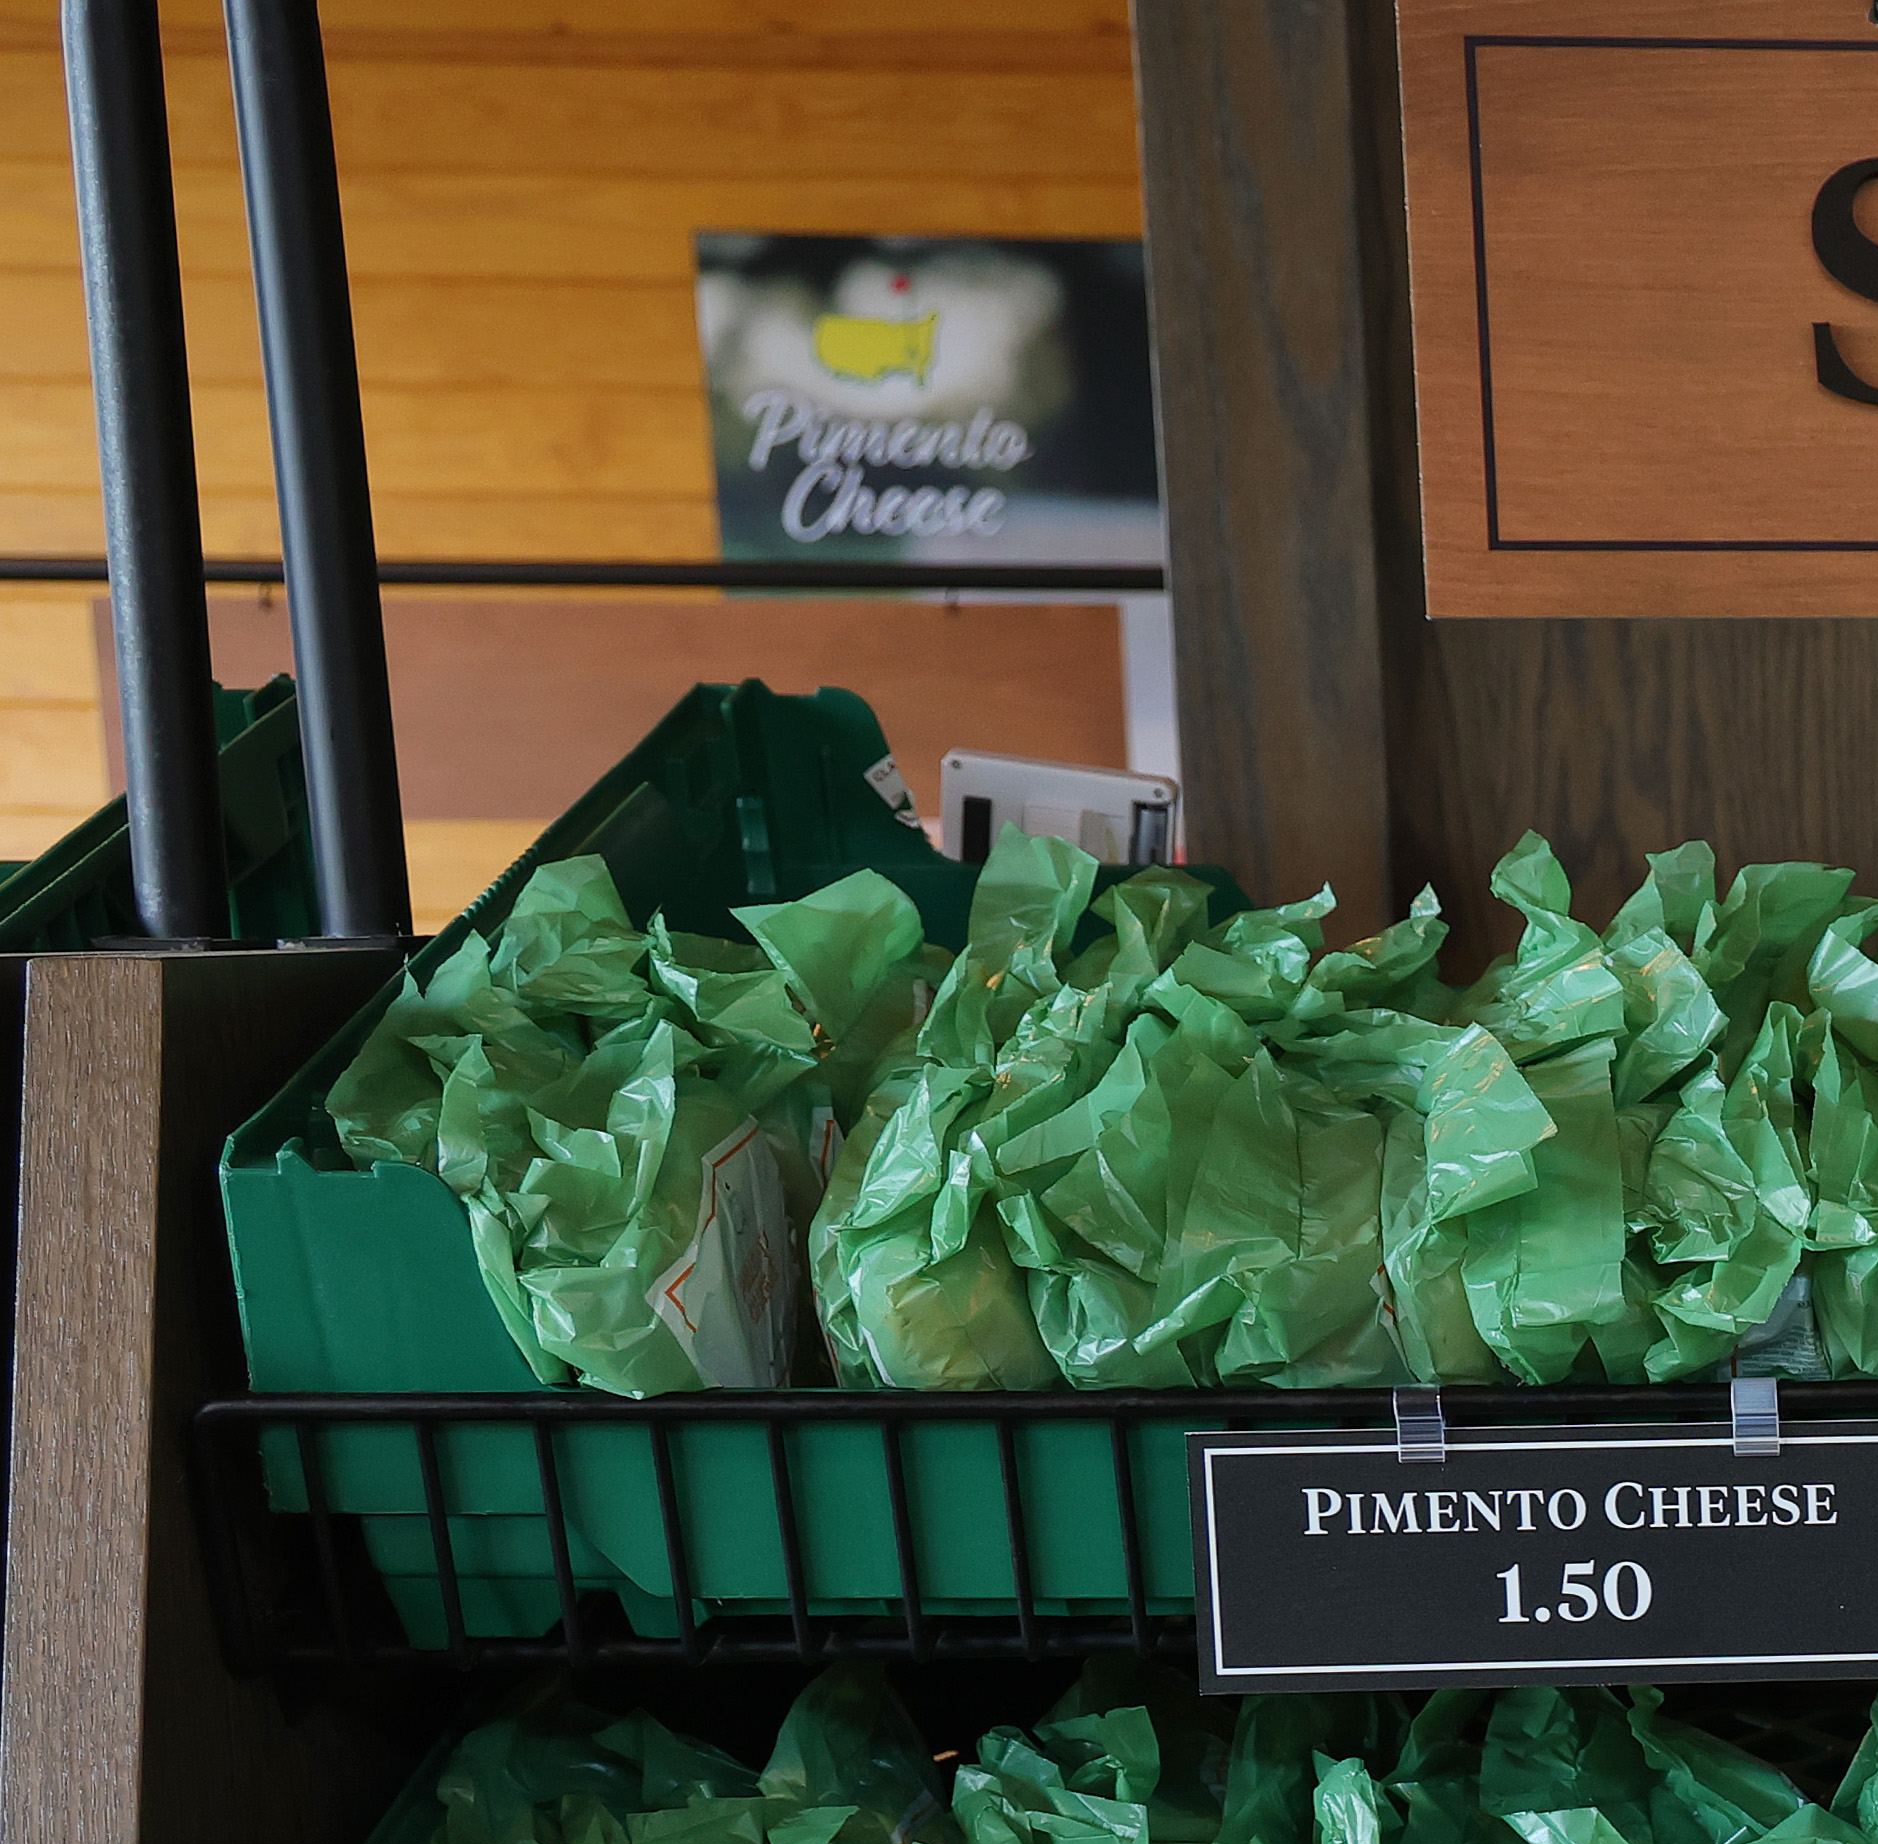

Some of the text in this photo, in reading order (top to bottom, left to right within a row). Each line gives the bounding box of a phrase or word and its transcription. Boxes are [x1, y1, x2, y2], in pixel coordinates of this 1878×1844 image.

[743, 391, 1034, 470] Pimento
[782, 458, 1008, 542] Cheese
[1301, 1481, 1838, 1535] PIMENTO CHEESE
[1496, 1559, 1652, 1623] 1.50
